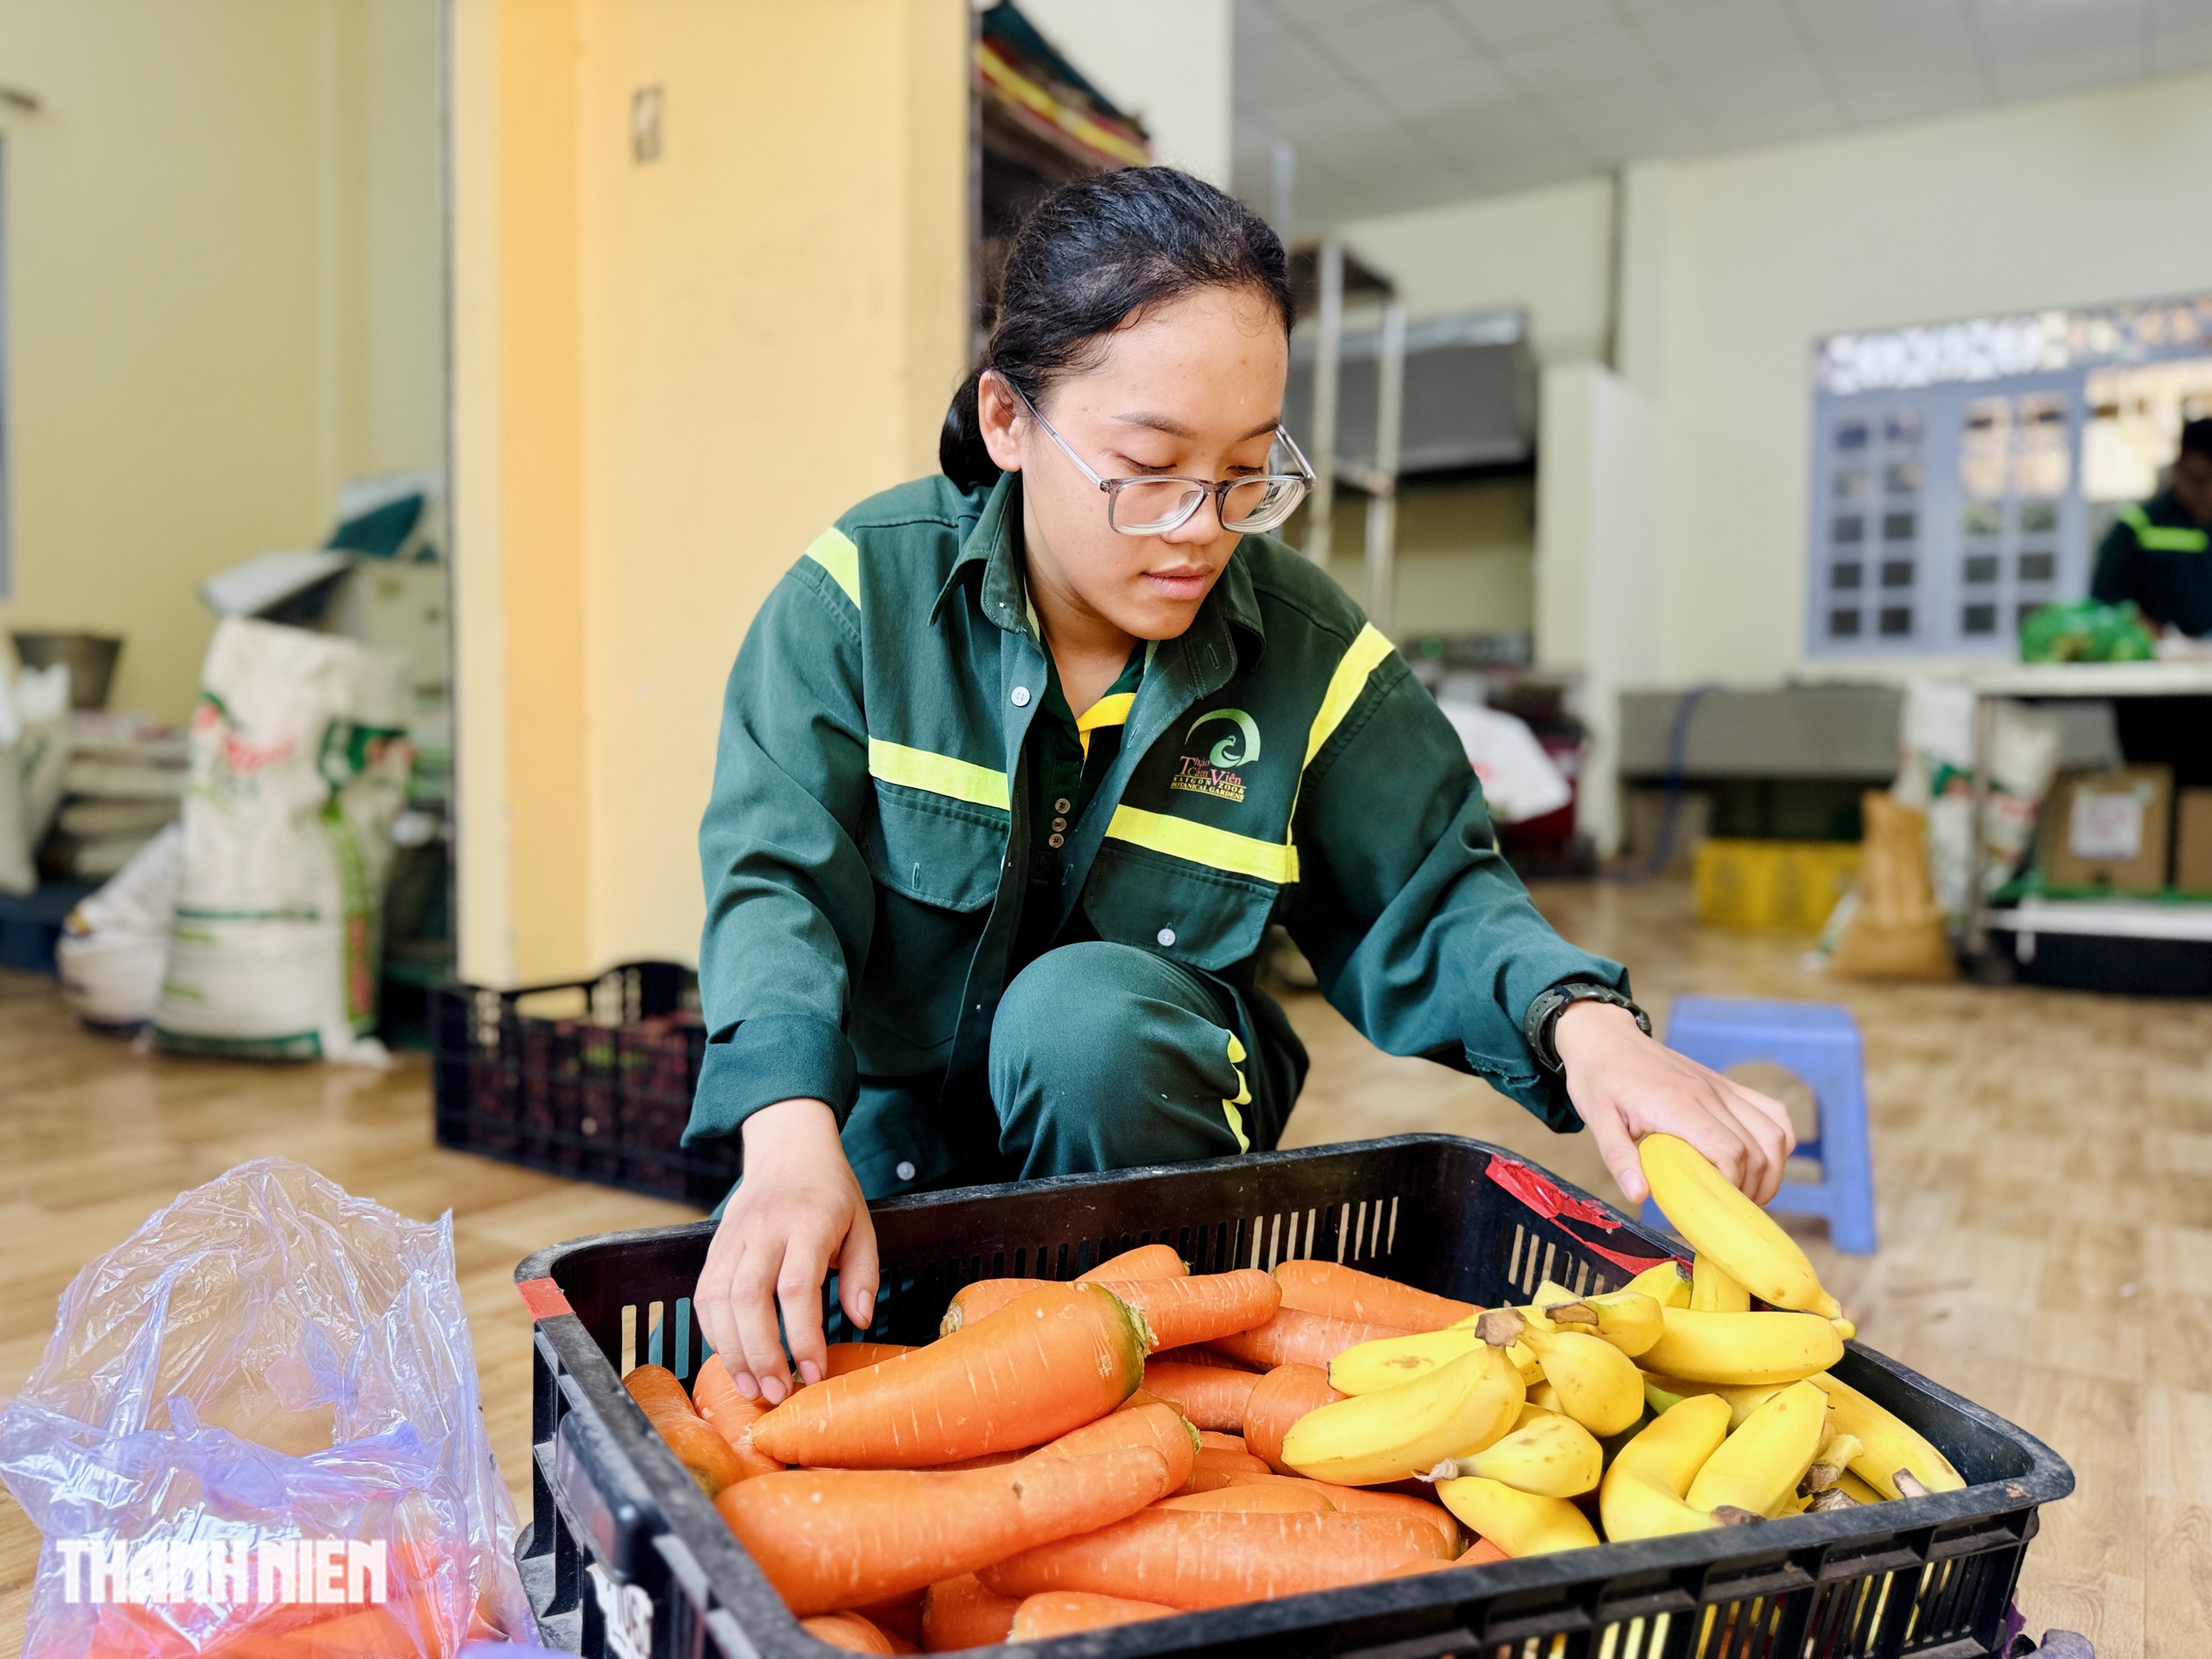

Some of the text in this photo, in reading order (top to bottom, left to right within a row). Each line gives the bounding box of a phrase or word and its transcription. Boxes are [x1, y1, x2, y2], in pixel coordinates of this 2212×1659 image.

[1173, 777, 1211, 785] SAIGON
[1210, 769, 1242, 785] Viên
[1172, 782, 1244, 800] BOTANICAL GARDENS
